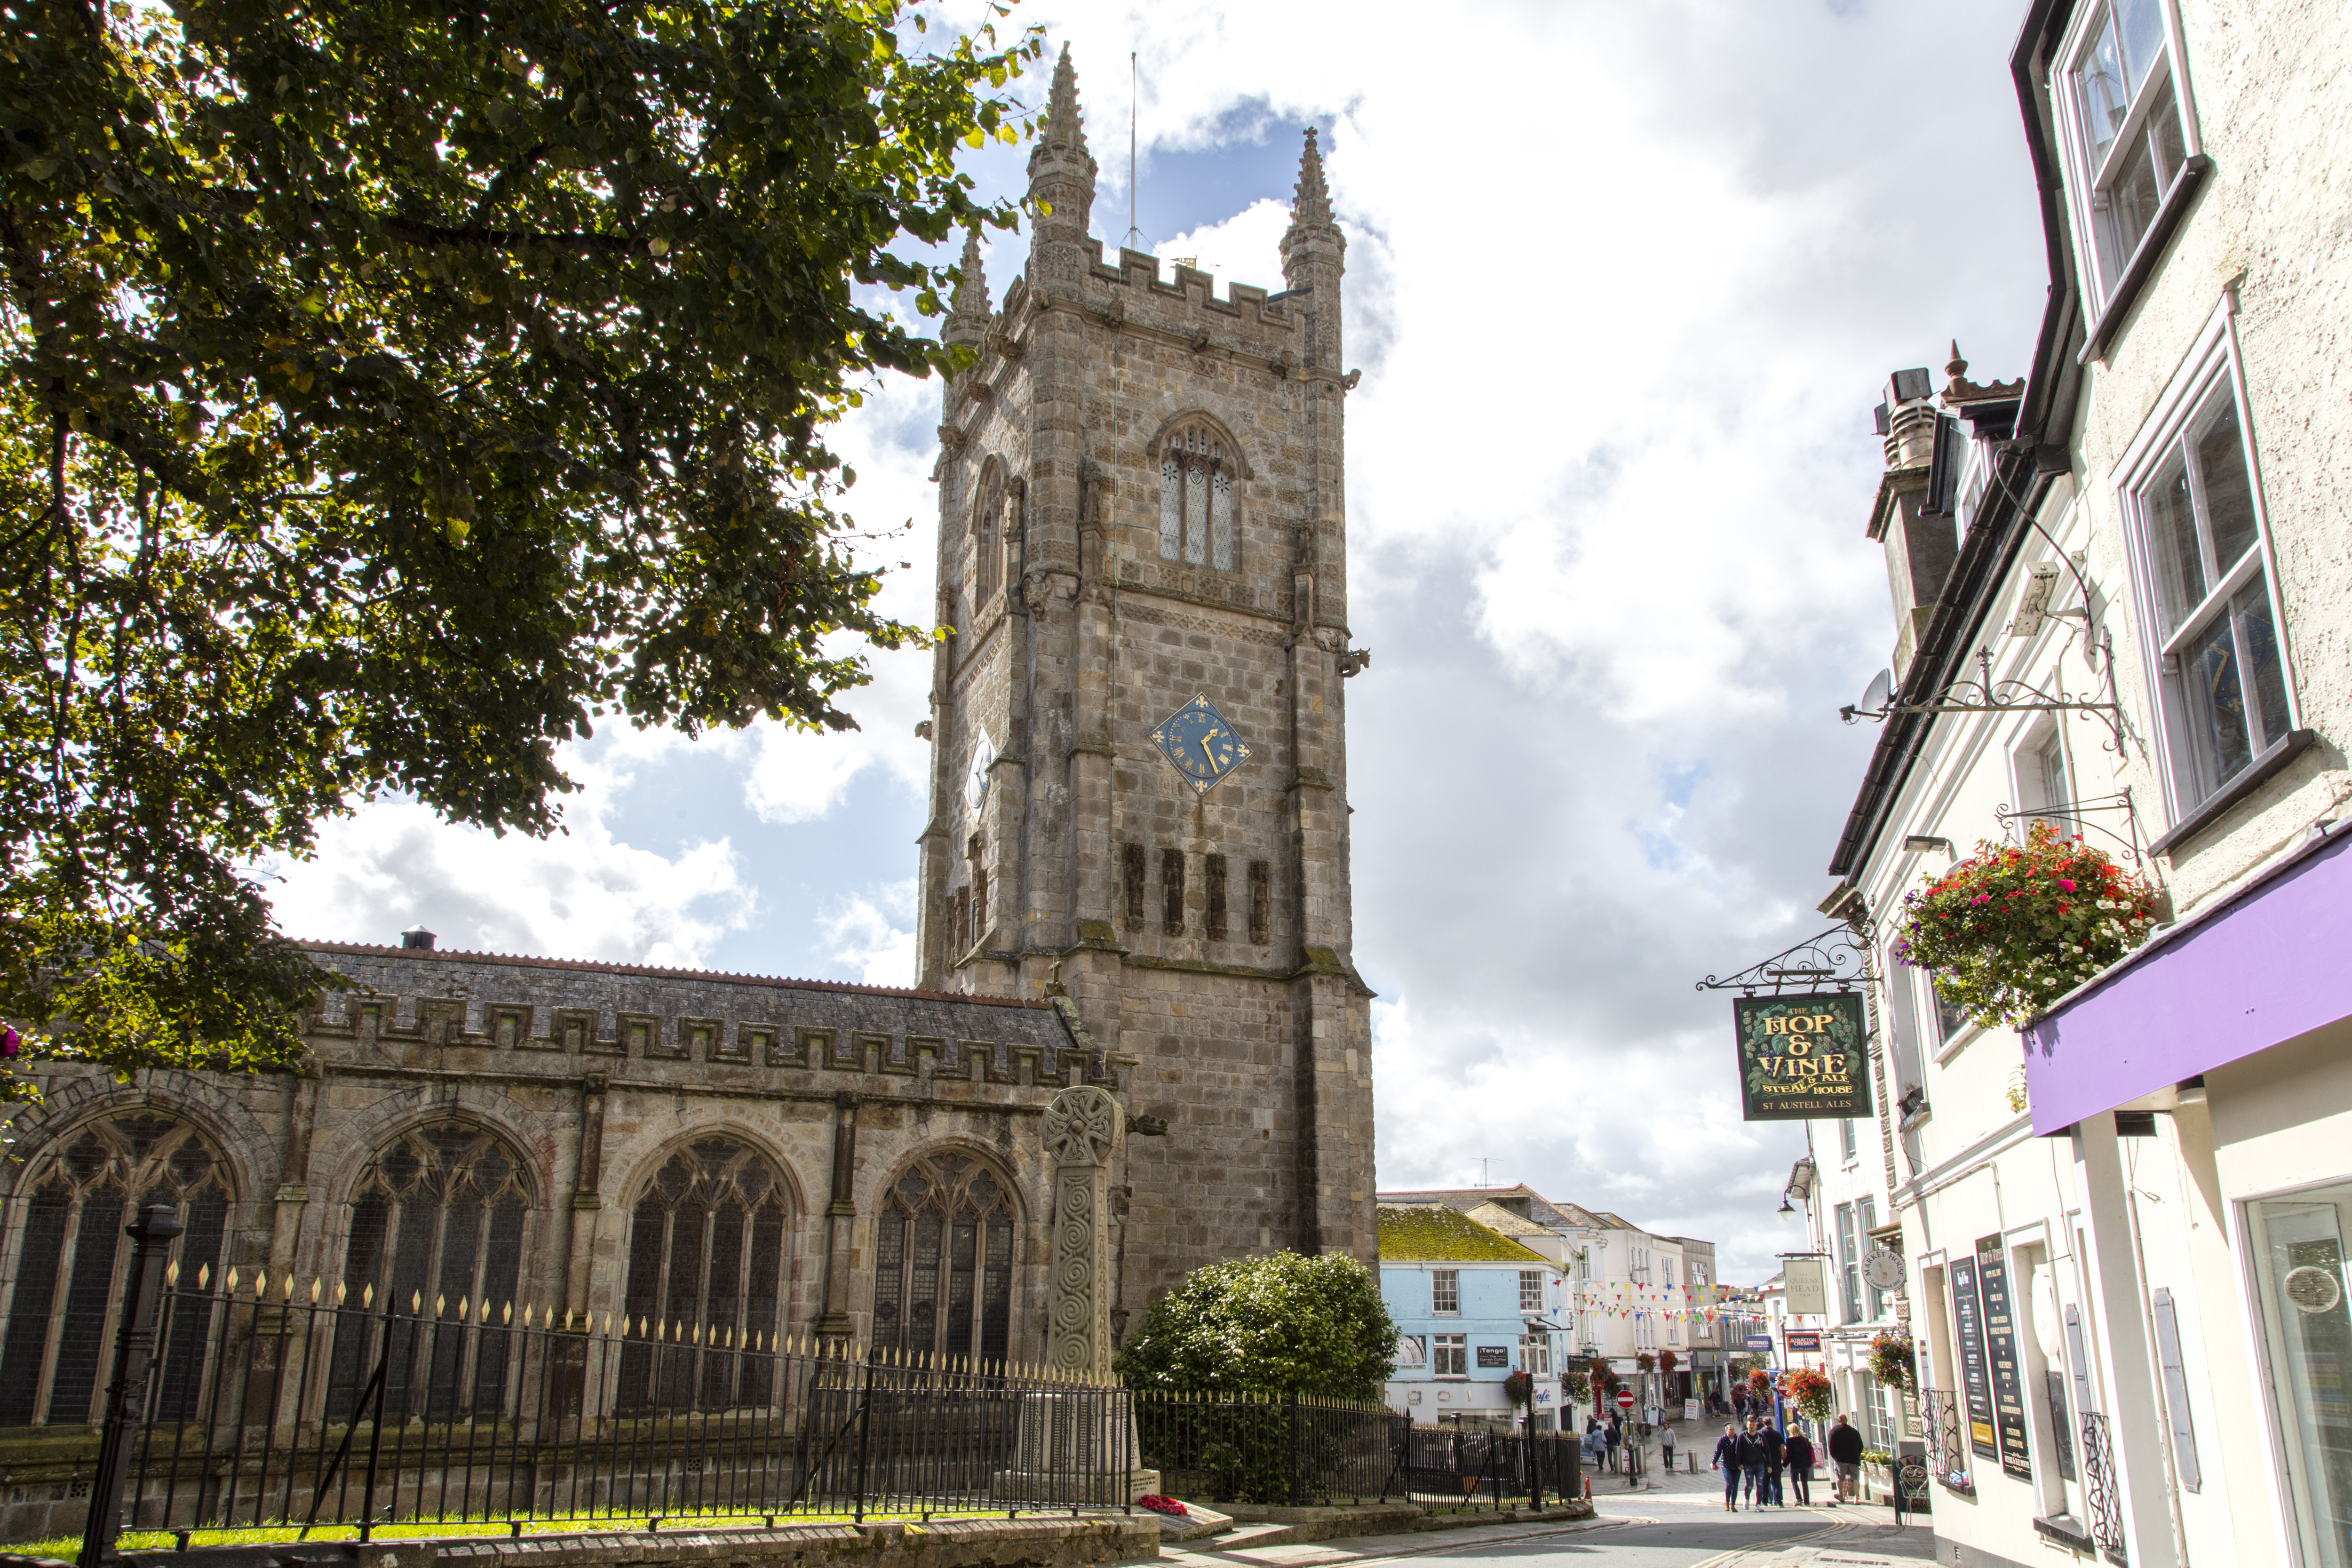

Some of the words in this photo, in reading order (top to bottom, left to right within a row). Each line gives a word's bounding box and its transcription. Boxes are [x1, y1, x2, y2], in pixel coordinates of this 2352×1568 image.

[1763, 1015, 1834, 1035] HOP
[1789, 1035, 1812, 1056] &
[1758, 1054, 1847, 1077] VINE
[1763, 1083, 1806, 1093] STEAK
[1814, 1086, 1853, 1094] HOUSE
[1864, 1251, 1885, 1276] MARKET
[1888, 1253, 1904, 1276] HOUSE
[1870, 1279, 1892, 1288] Established
